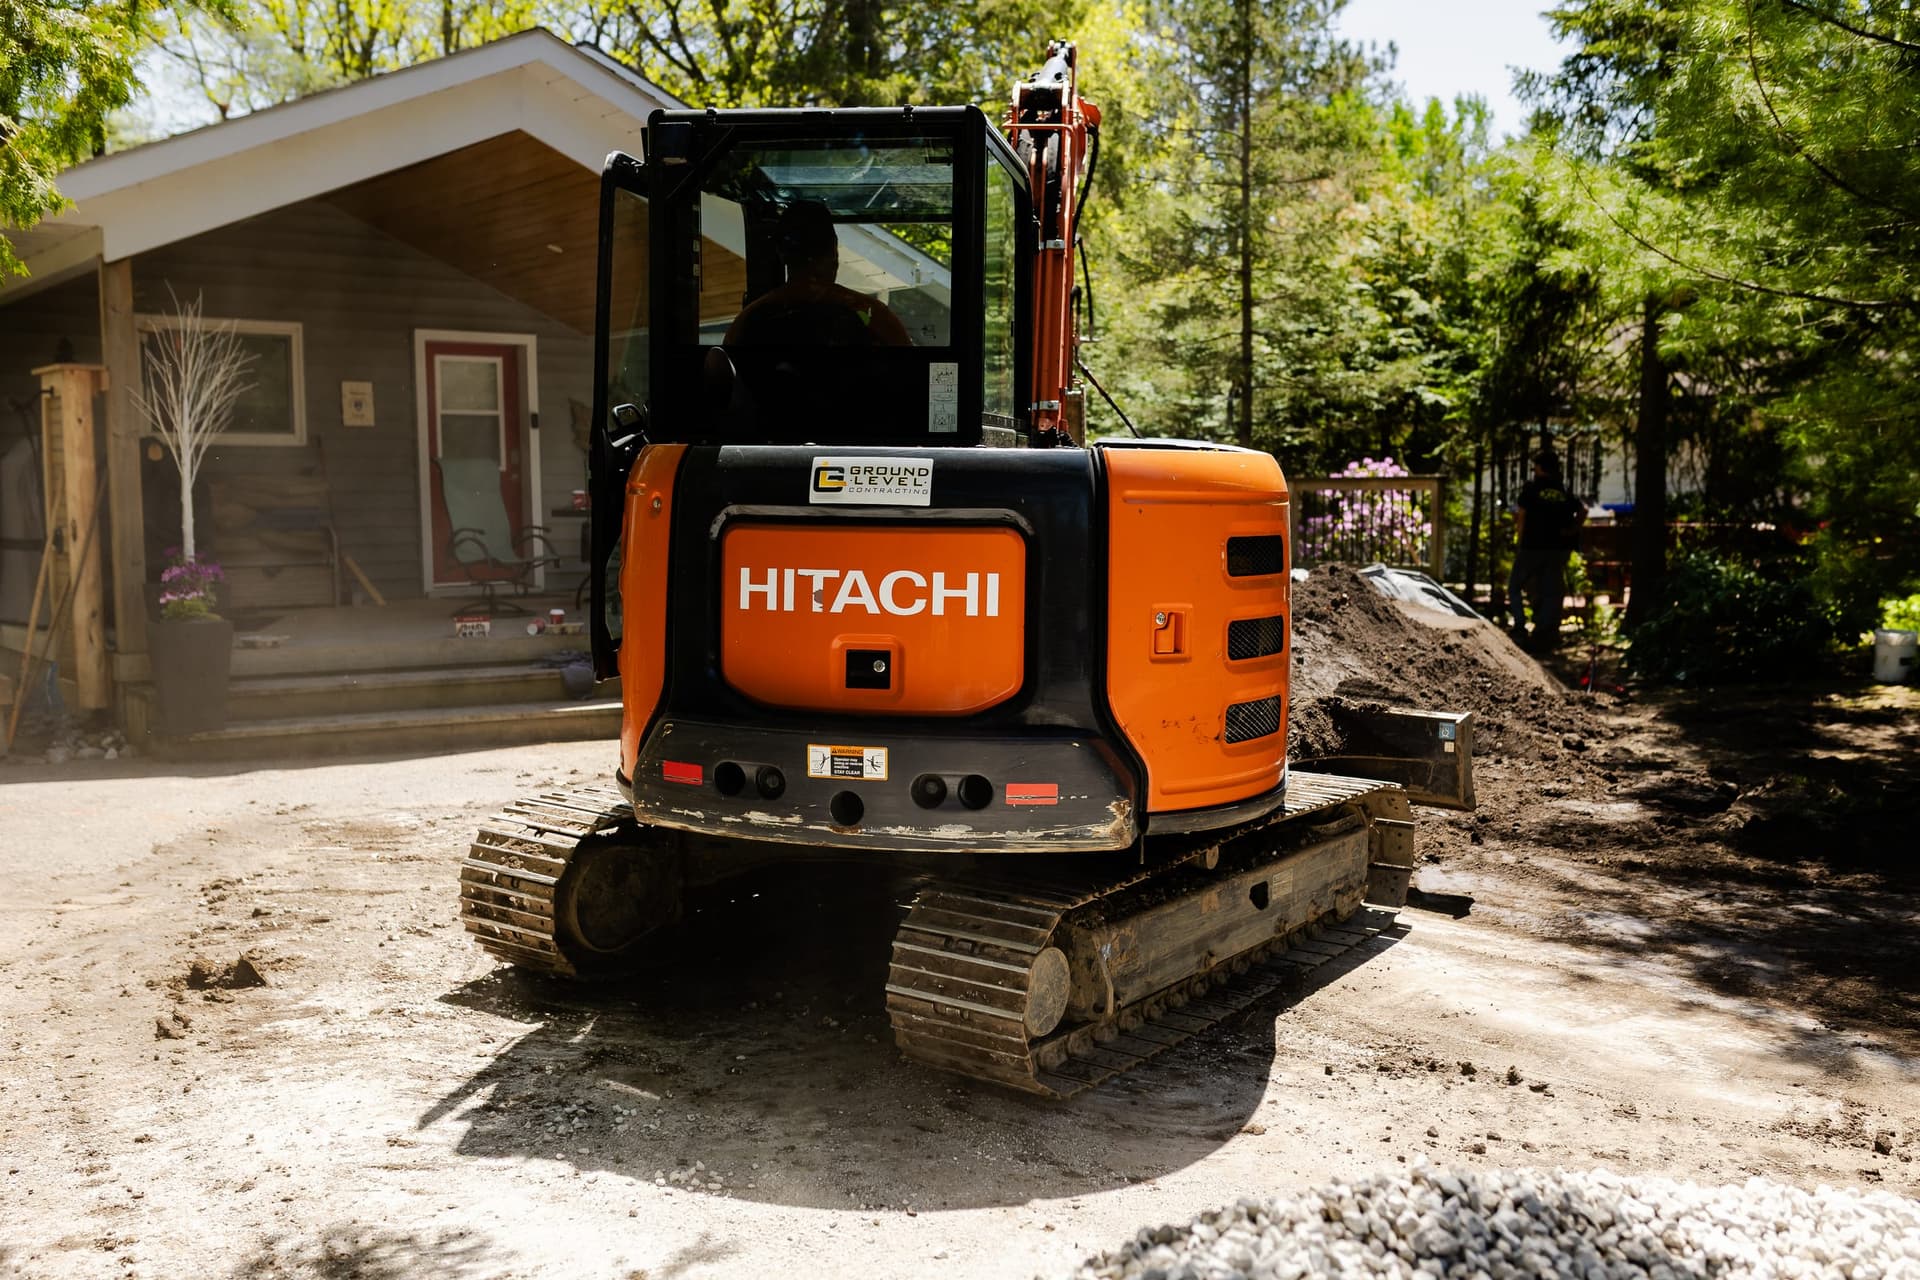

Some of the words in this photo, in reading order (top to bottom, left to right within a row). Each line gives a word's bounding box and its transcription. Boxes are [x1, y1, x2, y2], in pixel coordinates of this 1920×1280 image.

[850, 466, 929, 477] GROUND
[848, 487, 929, 495] CONTRACTING
[739, 567, 1000, 617] HITACHI
